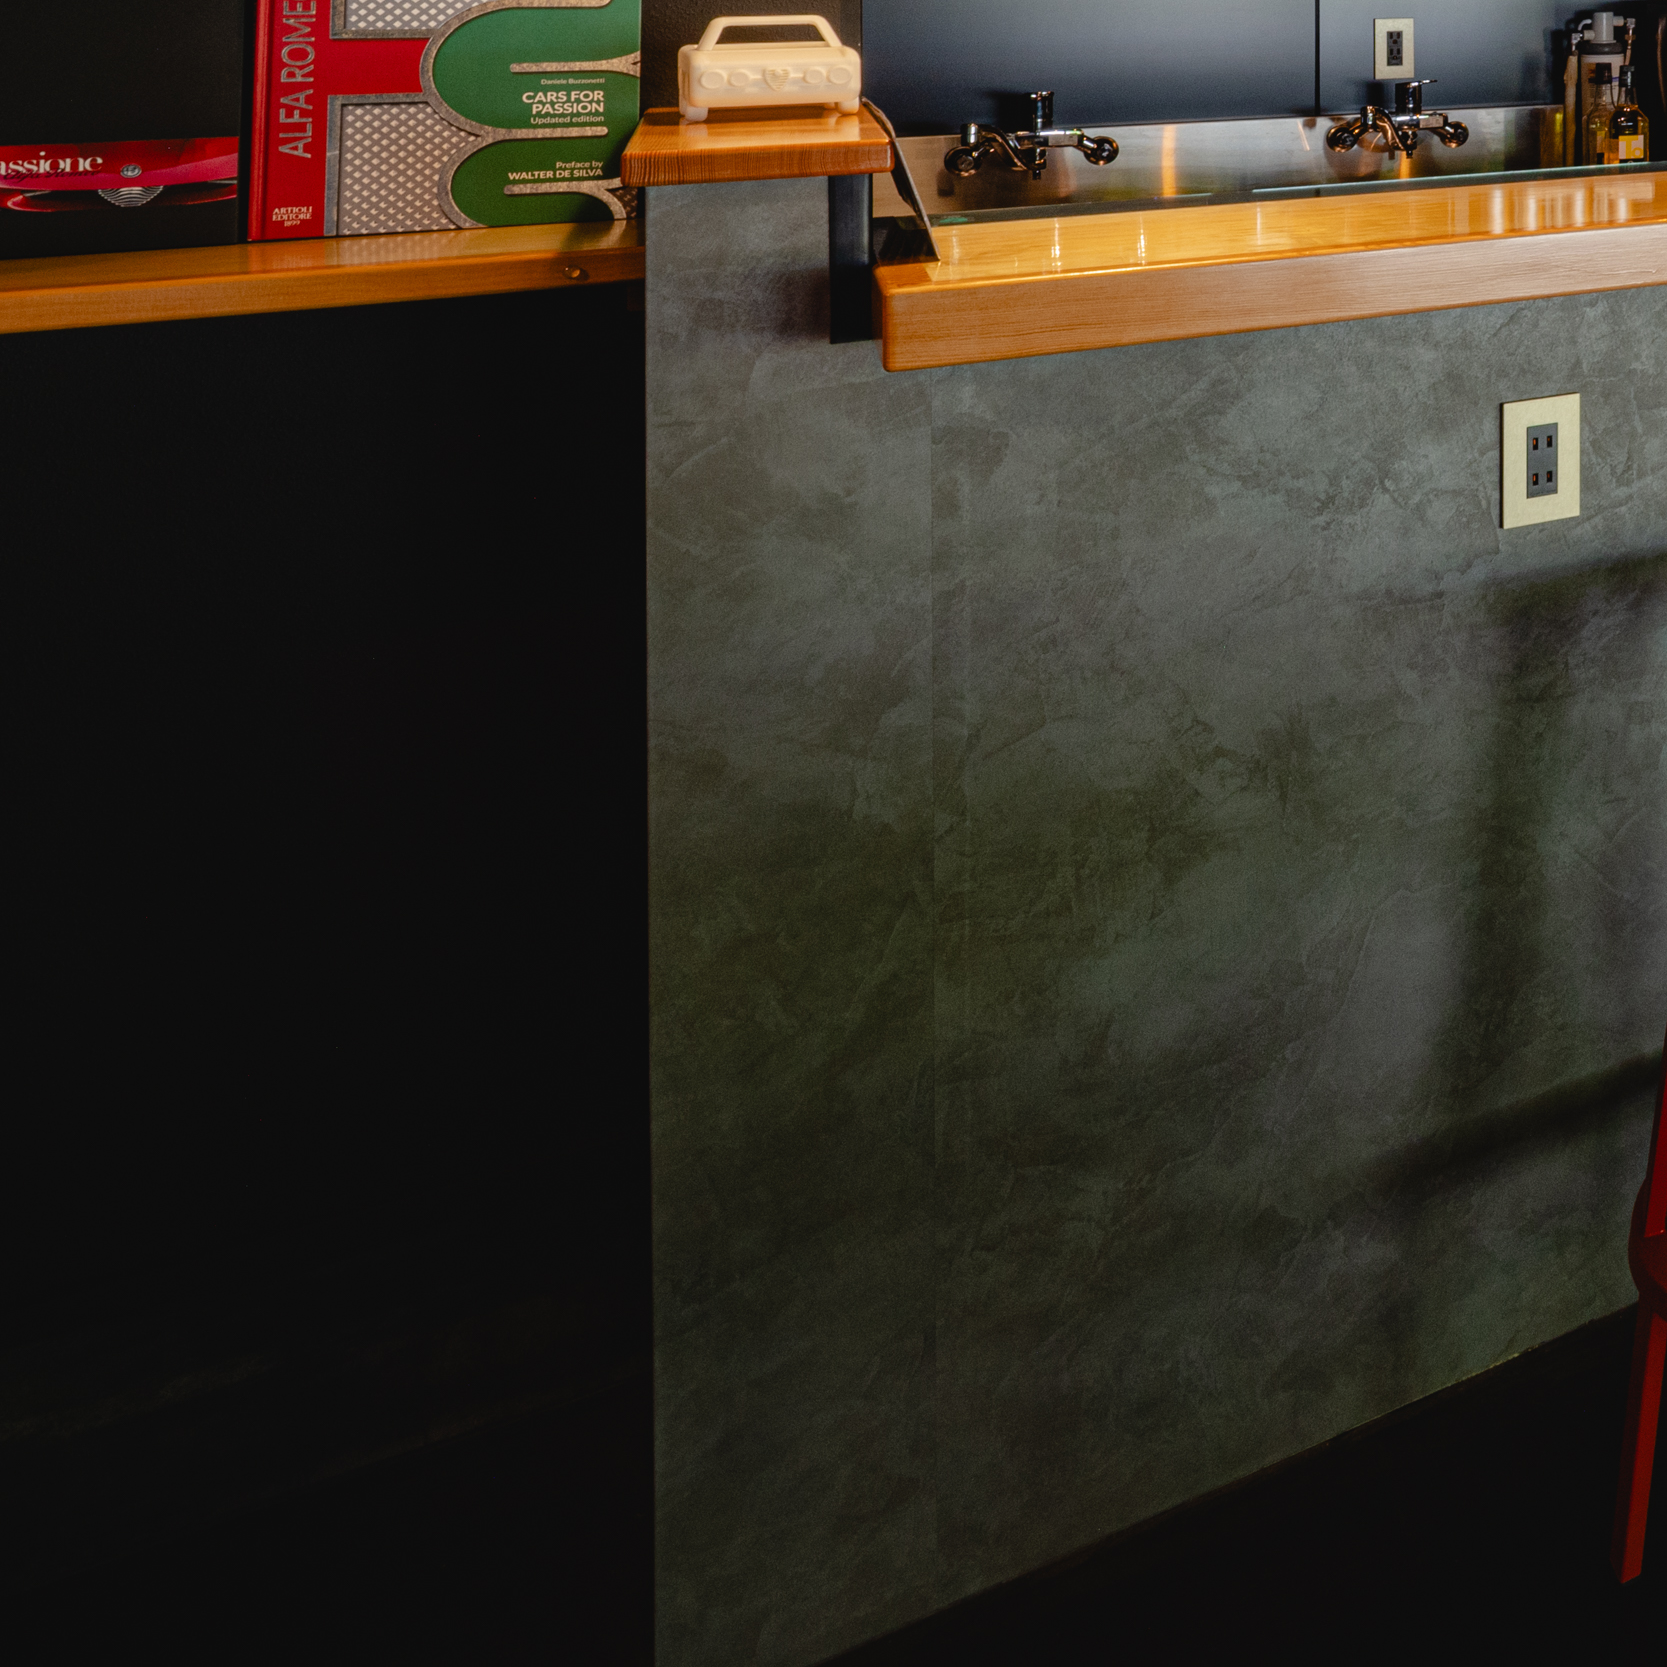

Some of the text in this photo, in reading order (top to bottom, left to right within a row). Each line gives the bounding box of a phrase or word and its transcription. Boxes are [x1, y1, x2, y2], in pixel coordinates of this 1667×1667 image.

[522, 90, 604, 103] CARS FOR
[532, 102, 604, 114] PASSION
[278, 89, 313, 158] ALFA
[530, 115, 604, 125] Updated edition
[556, 160, 603, 169] Preface by
[508, 169, 603, 180] WALTER DE SILVA
[272, 206, 313, 214] ARTIOLI
[272, 213, 312, 221] EDITORE
